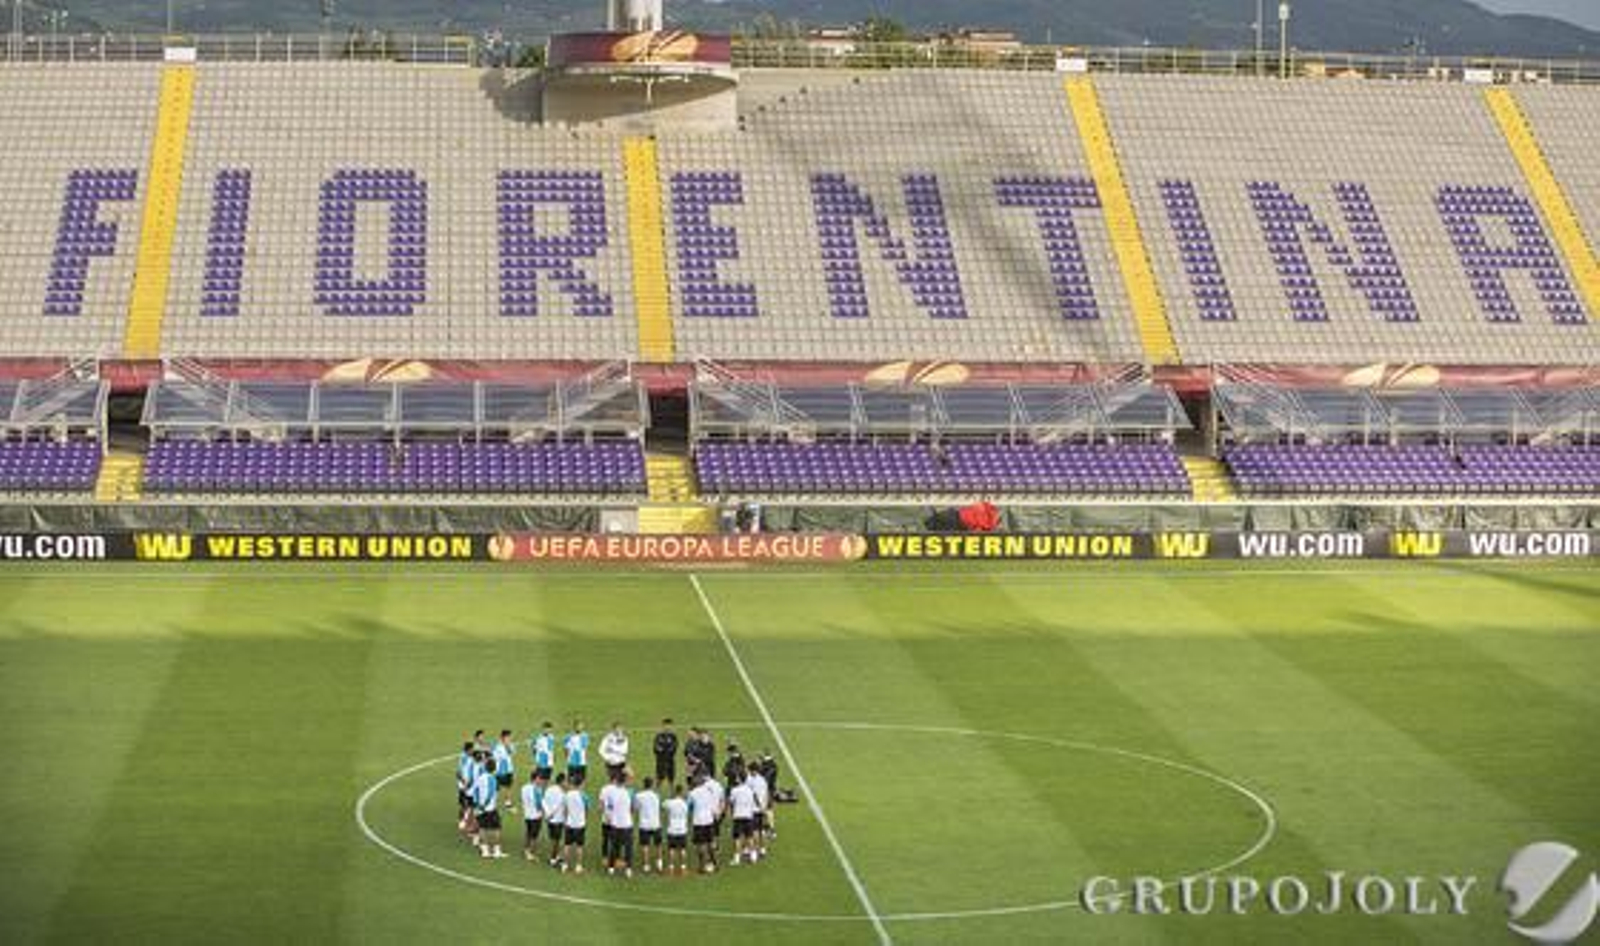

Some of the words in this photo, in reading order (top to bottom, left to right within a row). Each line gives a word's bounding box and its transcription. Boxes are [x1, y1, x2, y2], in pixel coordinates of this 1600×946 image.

[43, 167, 1588, 326] FIORENTINA
[0, 533, 105, 558] u.com
[138, 533, 192, 559] WU
[208, 536, 365, 557] WESTERN
[368, 536, 472, 557] UNION
[529, 537, 600, 558] UEFA
[607, 537, 715, 558] EUROPA
[722, 537, 825, 558] LEAGUE
[877, 536, 1026, 556] WESTERN
[1033, 536, 1133, 556] UNION
[1158, 533, 1210, 557] WU
[1238, 533, 1364, 557] wu.com
[1391, 533, 1442, 557] WU
[1470, 533, 1590, 557] wu.com
